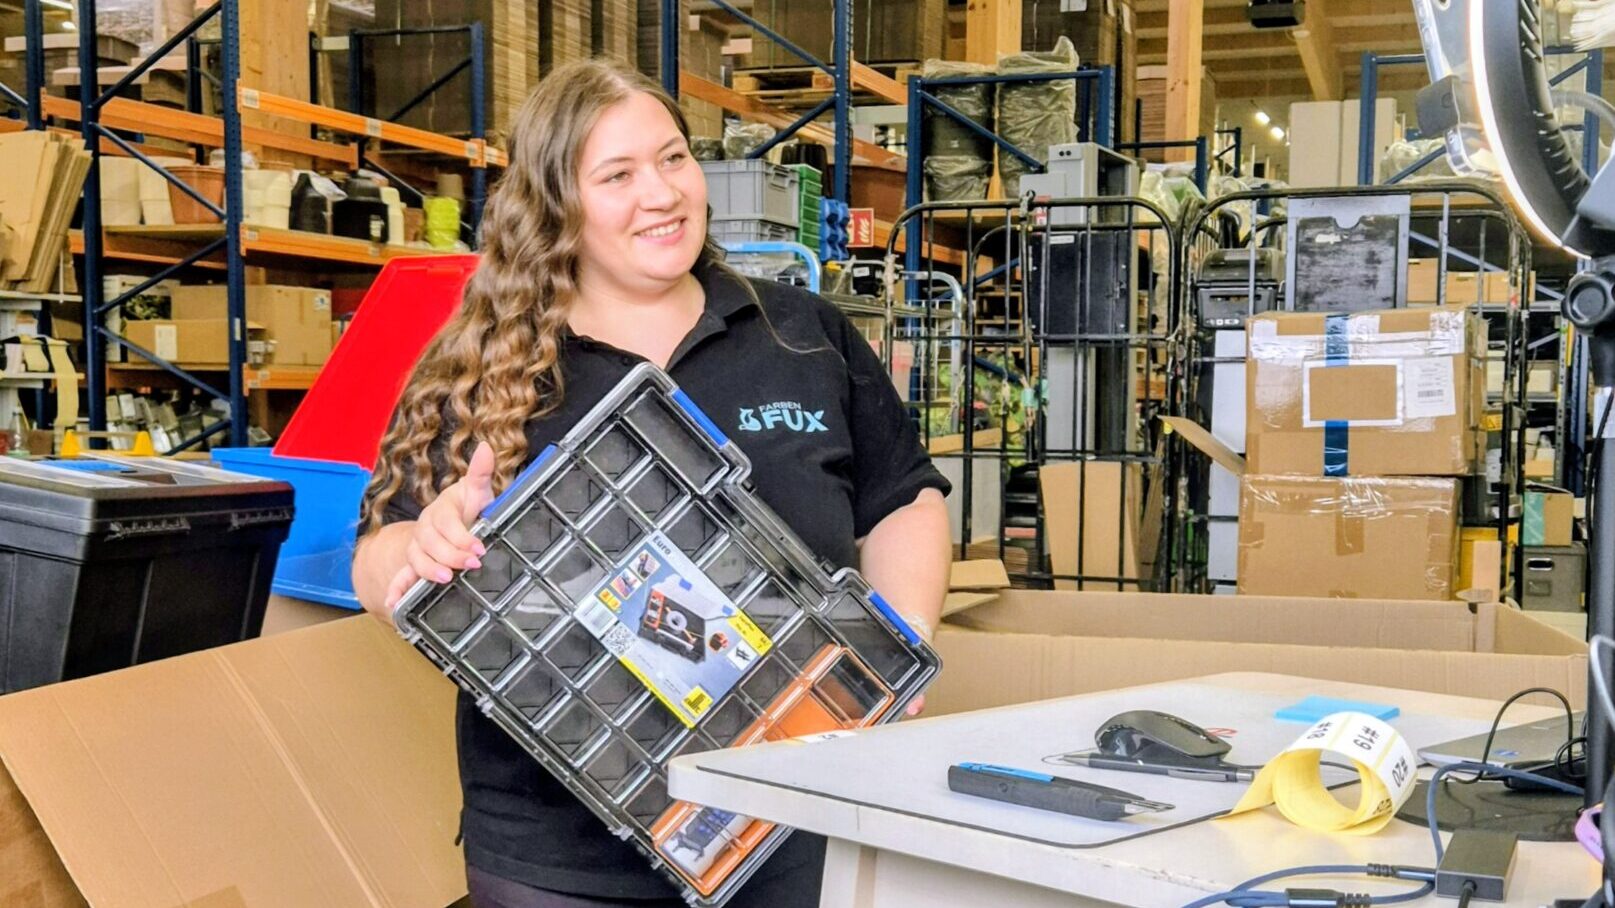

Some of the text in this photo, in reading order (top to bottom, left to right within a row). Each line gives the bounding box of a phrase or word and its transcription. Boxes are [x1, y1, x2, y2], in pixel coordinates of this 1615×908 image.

[758, 401, 802, 412] FARBEN
[761, 408, 829, 432] FUX
[1352, 725, 1380, 751] #19
[1391, 756, 1409, 788] #20
